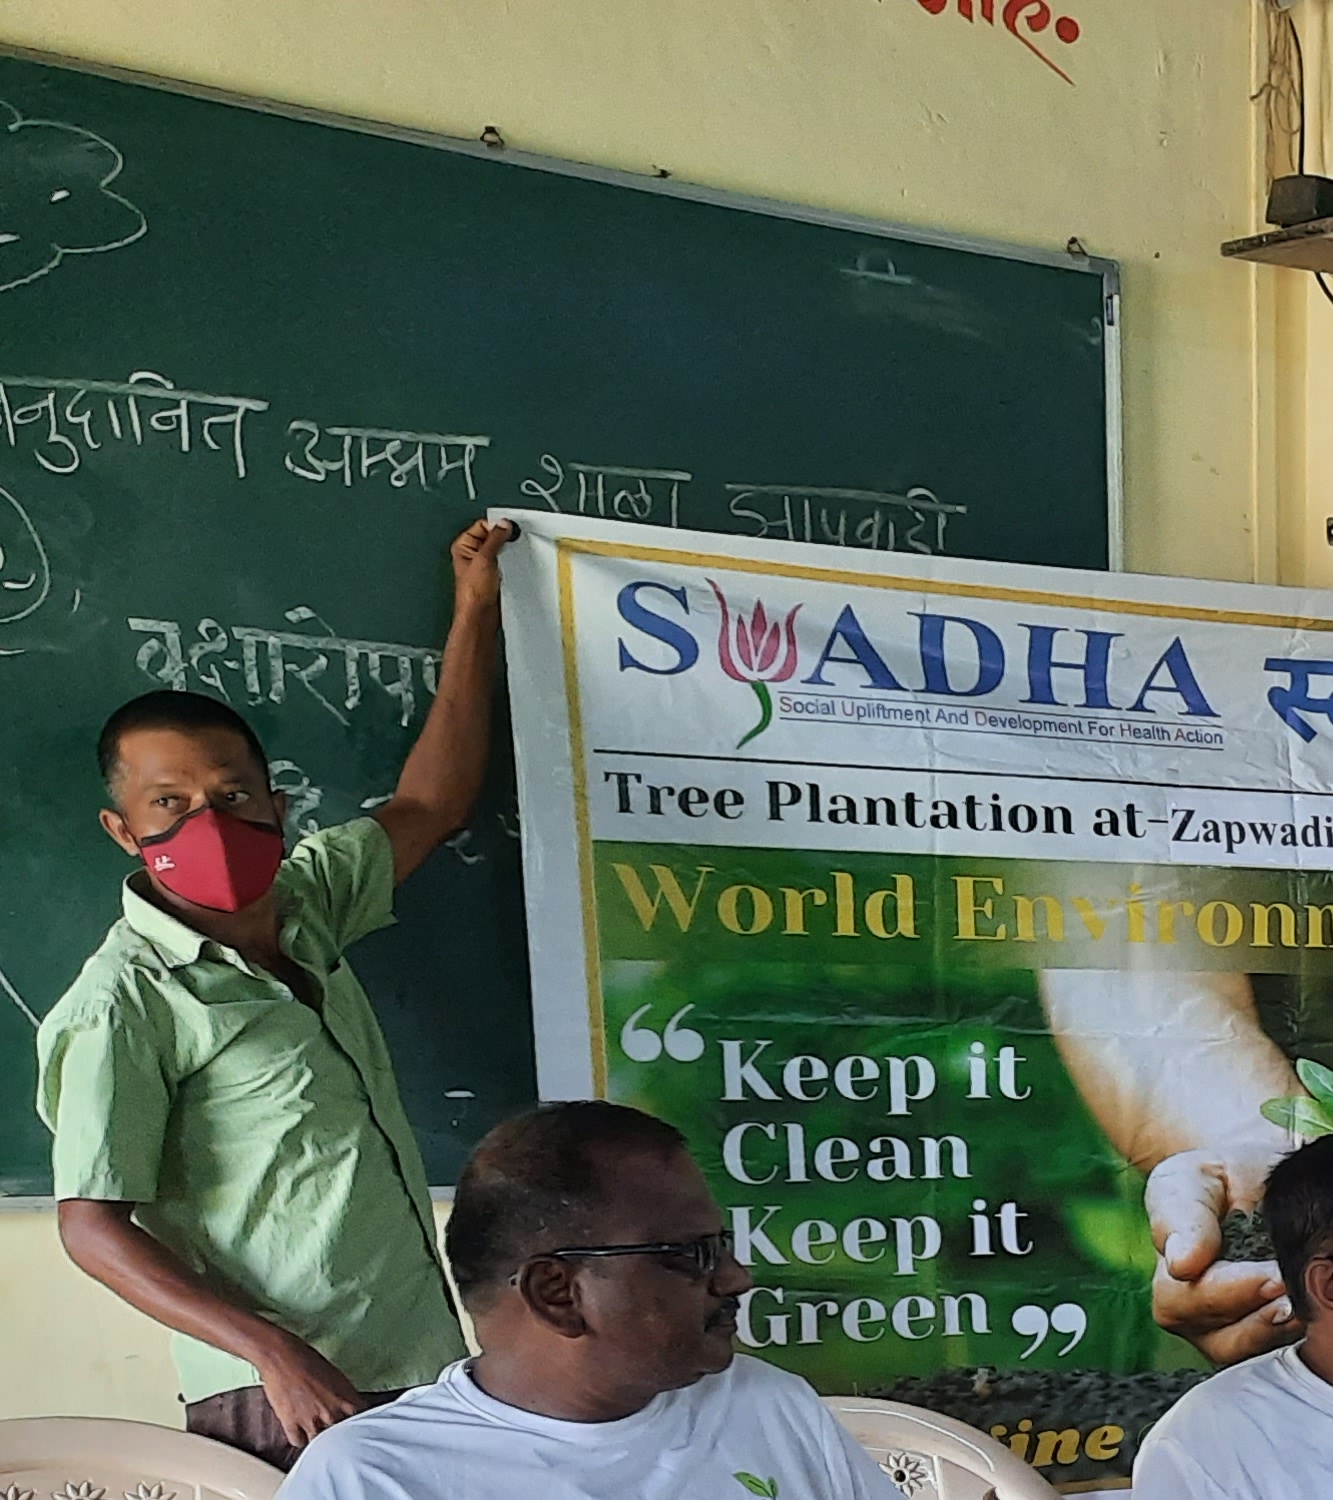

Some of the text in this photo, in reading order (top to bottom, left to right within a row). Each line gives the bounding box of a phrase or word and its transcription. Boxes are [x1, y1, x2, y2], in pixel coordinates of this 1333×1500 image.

[779, 696, 1224, 745] Social Upliftment And Development For Health Action
[603, 772, 745, 819] Tree
[766, 780, 1075, 836] Plantation
[611, 862, 921, 940] World
[718, 1039, 937, 1116] Keep
[964, 1041, 1033, 1101] it
[722, 1122, 974, 1186] Clean
[727, 1199, 1035, 1277] Keep it
[736, 1286, 993, 1350] Green
